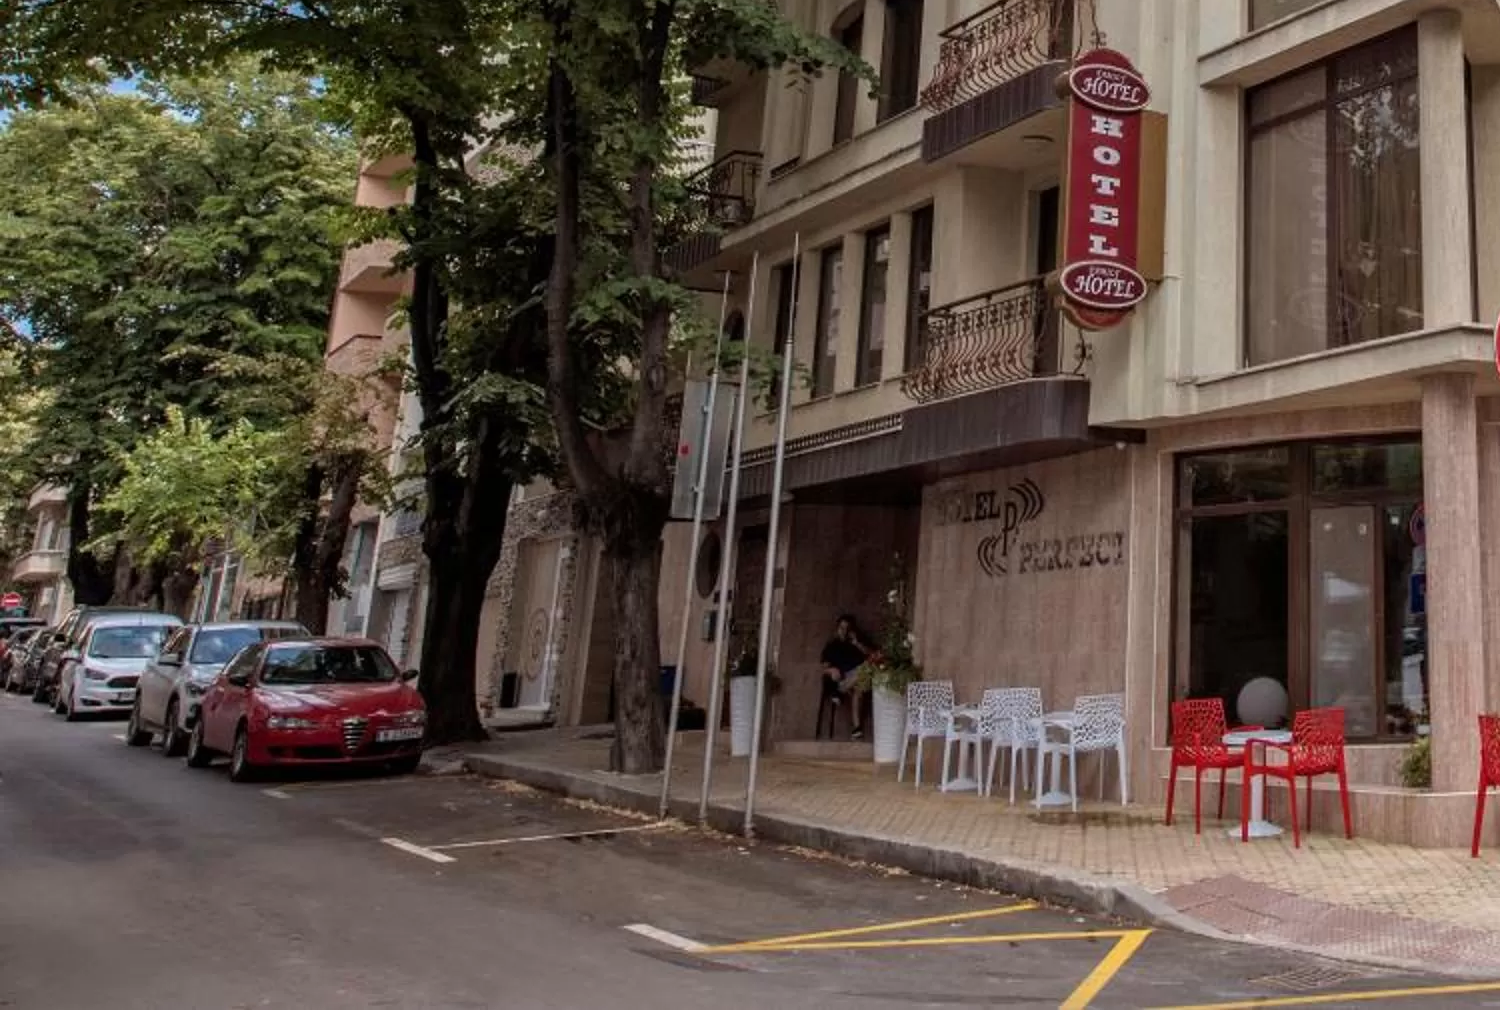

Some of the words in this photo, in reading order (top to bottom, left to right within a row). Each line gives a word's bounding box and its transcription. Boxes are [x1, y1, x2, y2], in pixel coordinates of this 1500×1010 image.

[1081, 77, 1141, 103] HOTEL
[1088, 114, 1124, 256] HOTEL
[1073, 275, 1135, 298] HOTEL
[934, 489, 1001, 526] TEL
